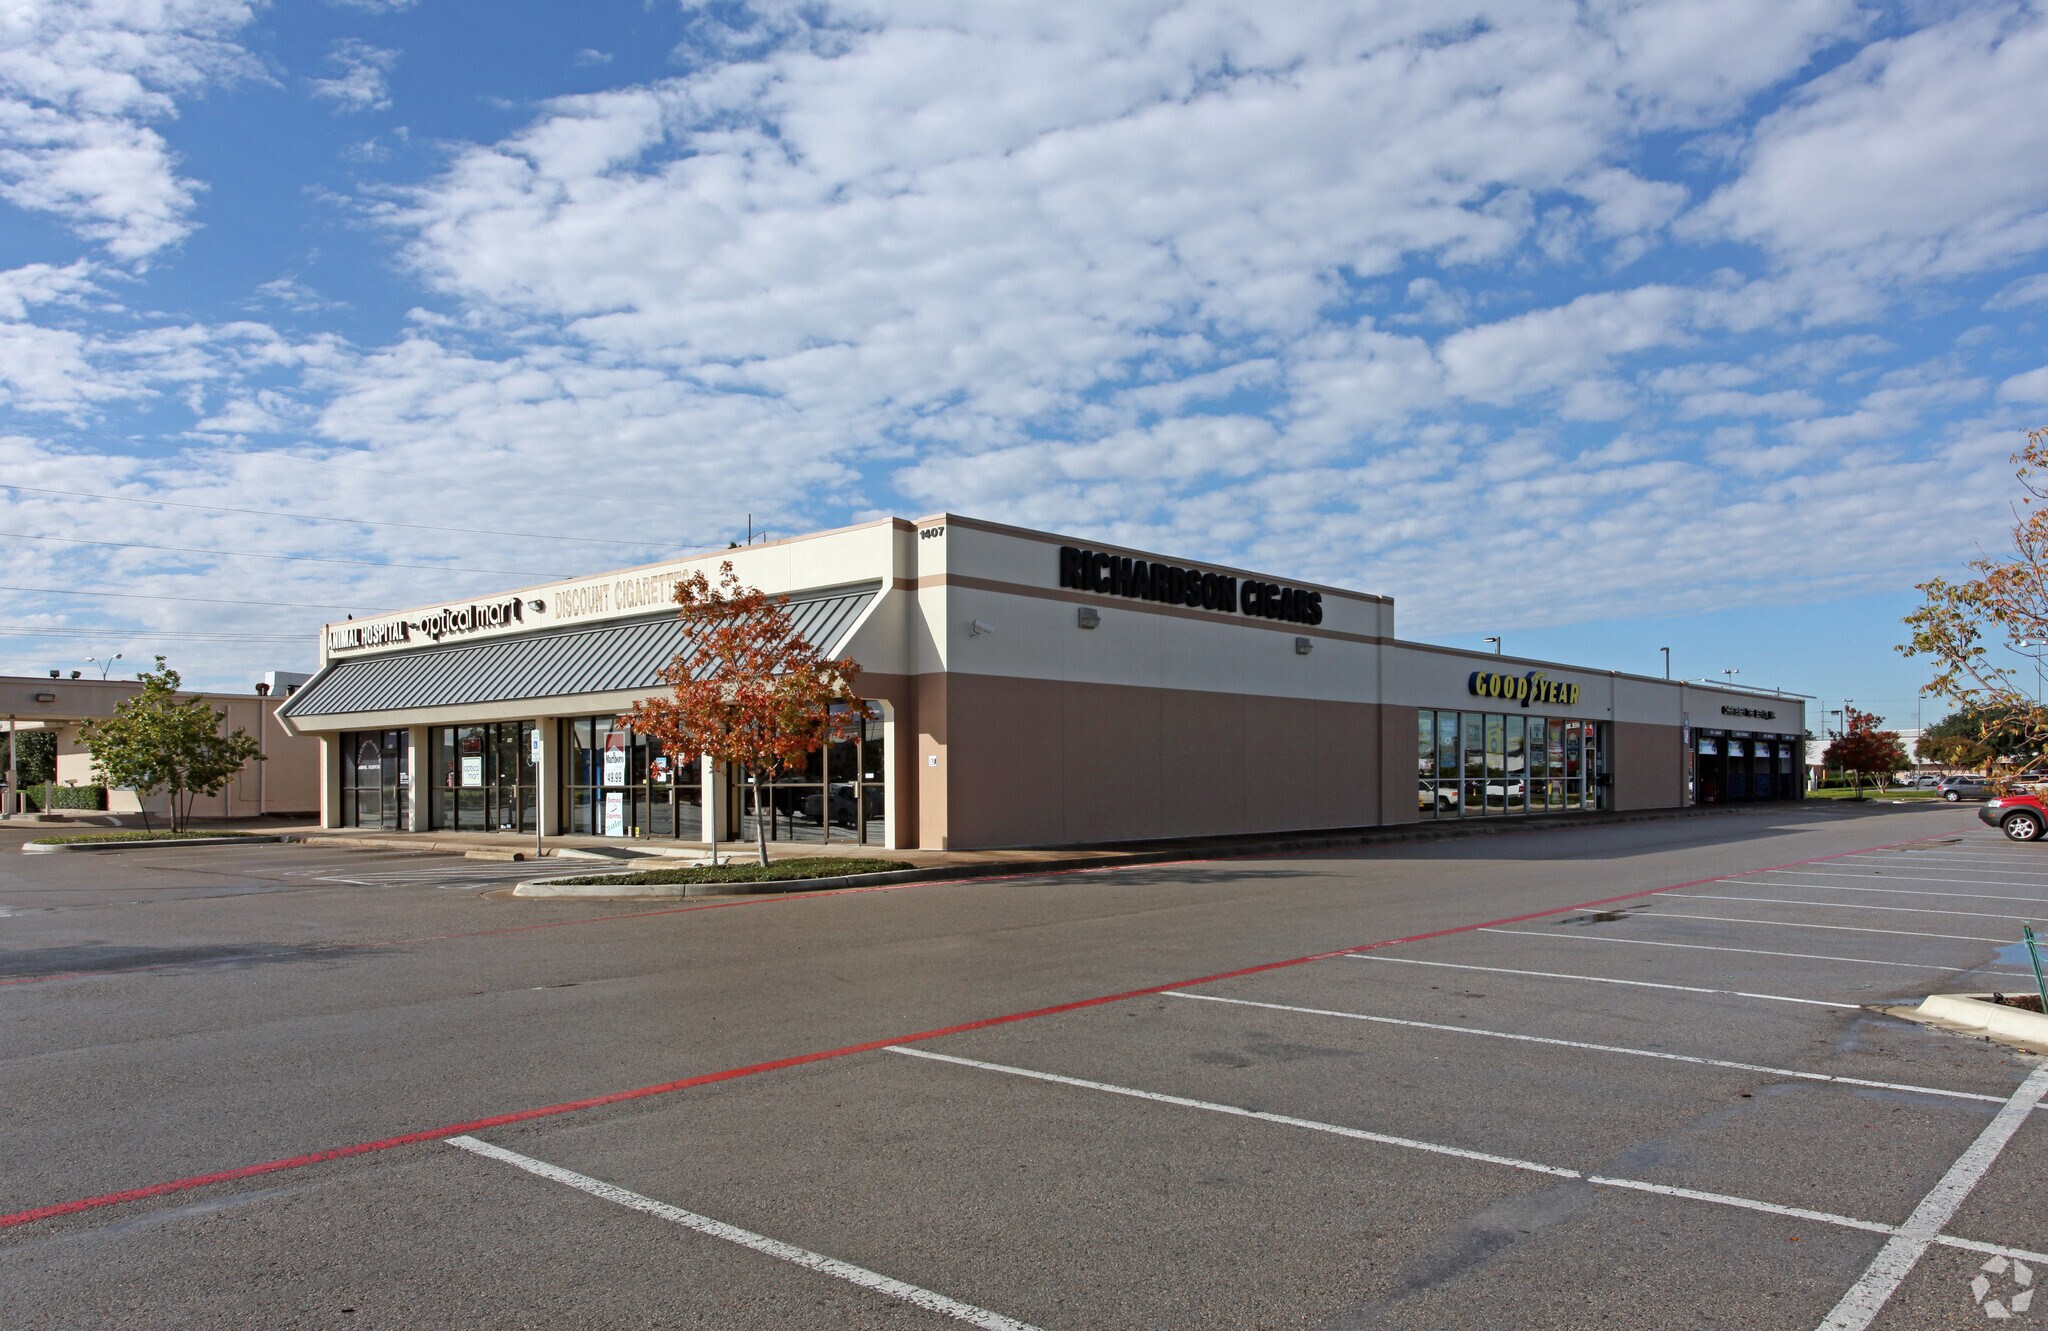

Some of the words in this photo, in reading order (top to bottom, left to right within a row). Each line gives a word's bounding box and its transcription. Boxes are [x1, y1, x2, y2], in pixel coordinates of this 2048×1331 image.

[920, 526, 945, 540] 1407
[555, 583, 610, 620] DISCOUNT
[1060, 546, 1237, 613] RICHARDSON
[1240, 580, 1323, 626] CIGARS
[328, 628, 360, 650] ANIMAL
[361, 620, 406, 648] HOSPITAL
[419, 605, 474, 638] optical
[475, 598, 521, 627] mart
[1469, 671, 1580, 707] GOODYEAR
[605, 752, 625, 764] Marlboro
